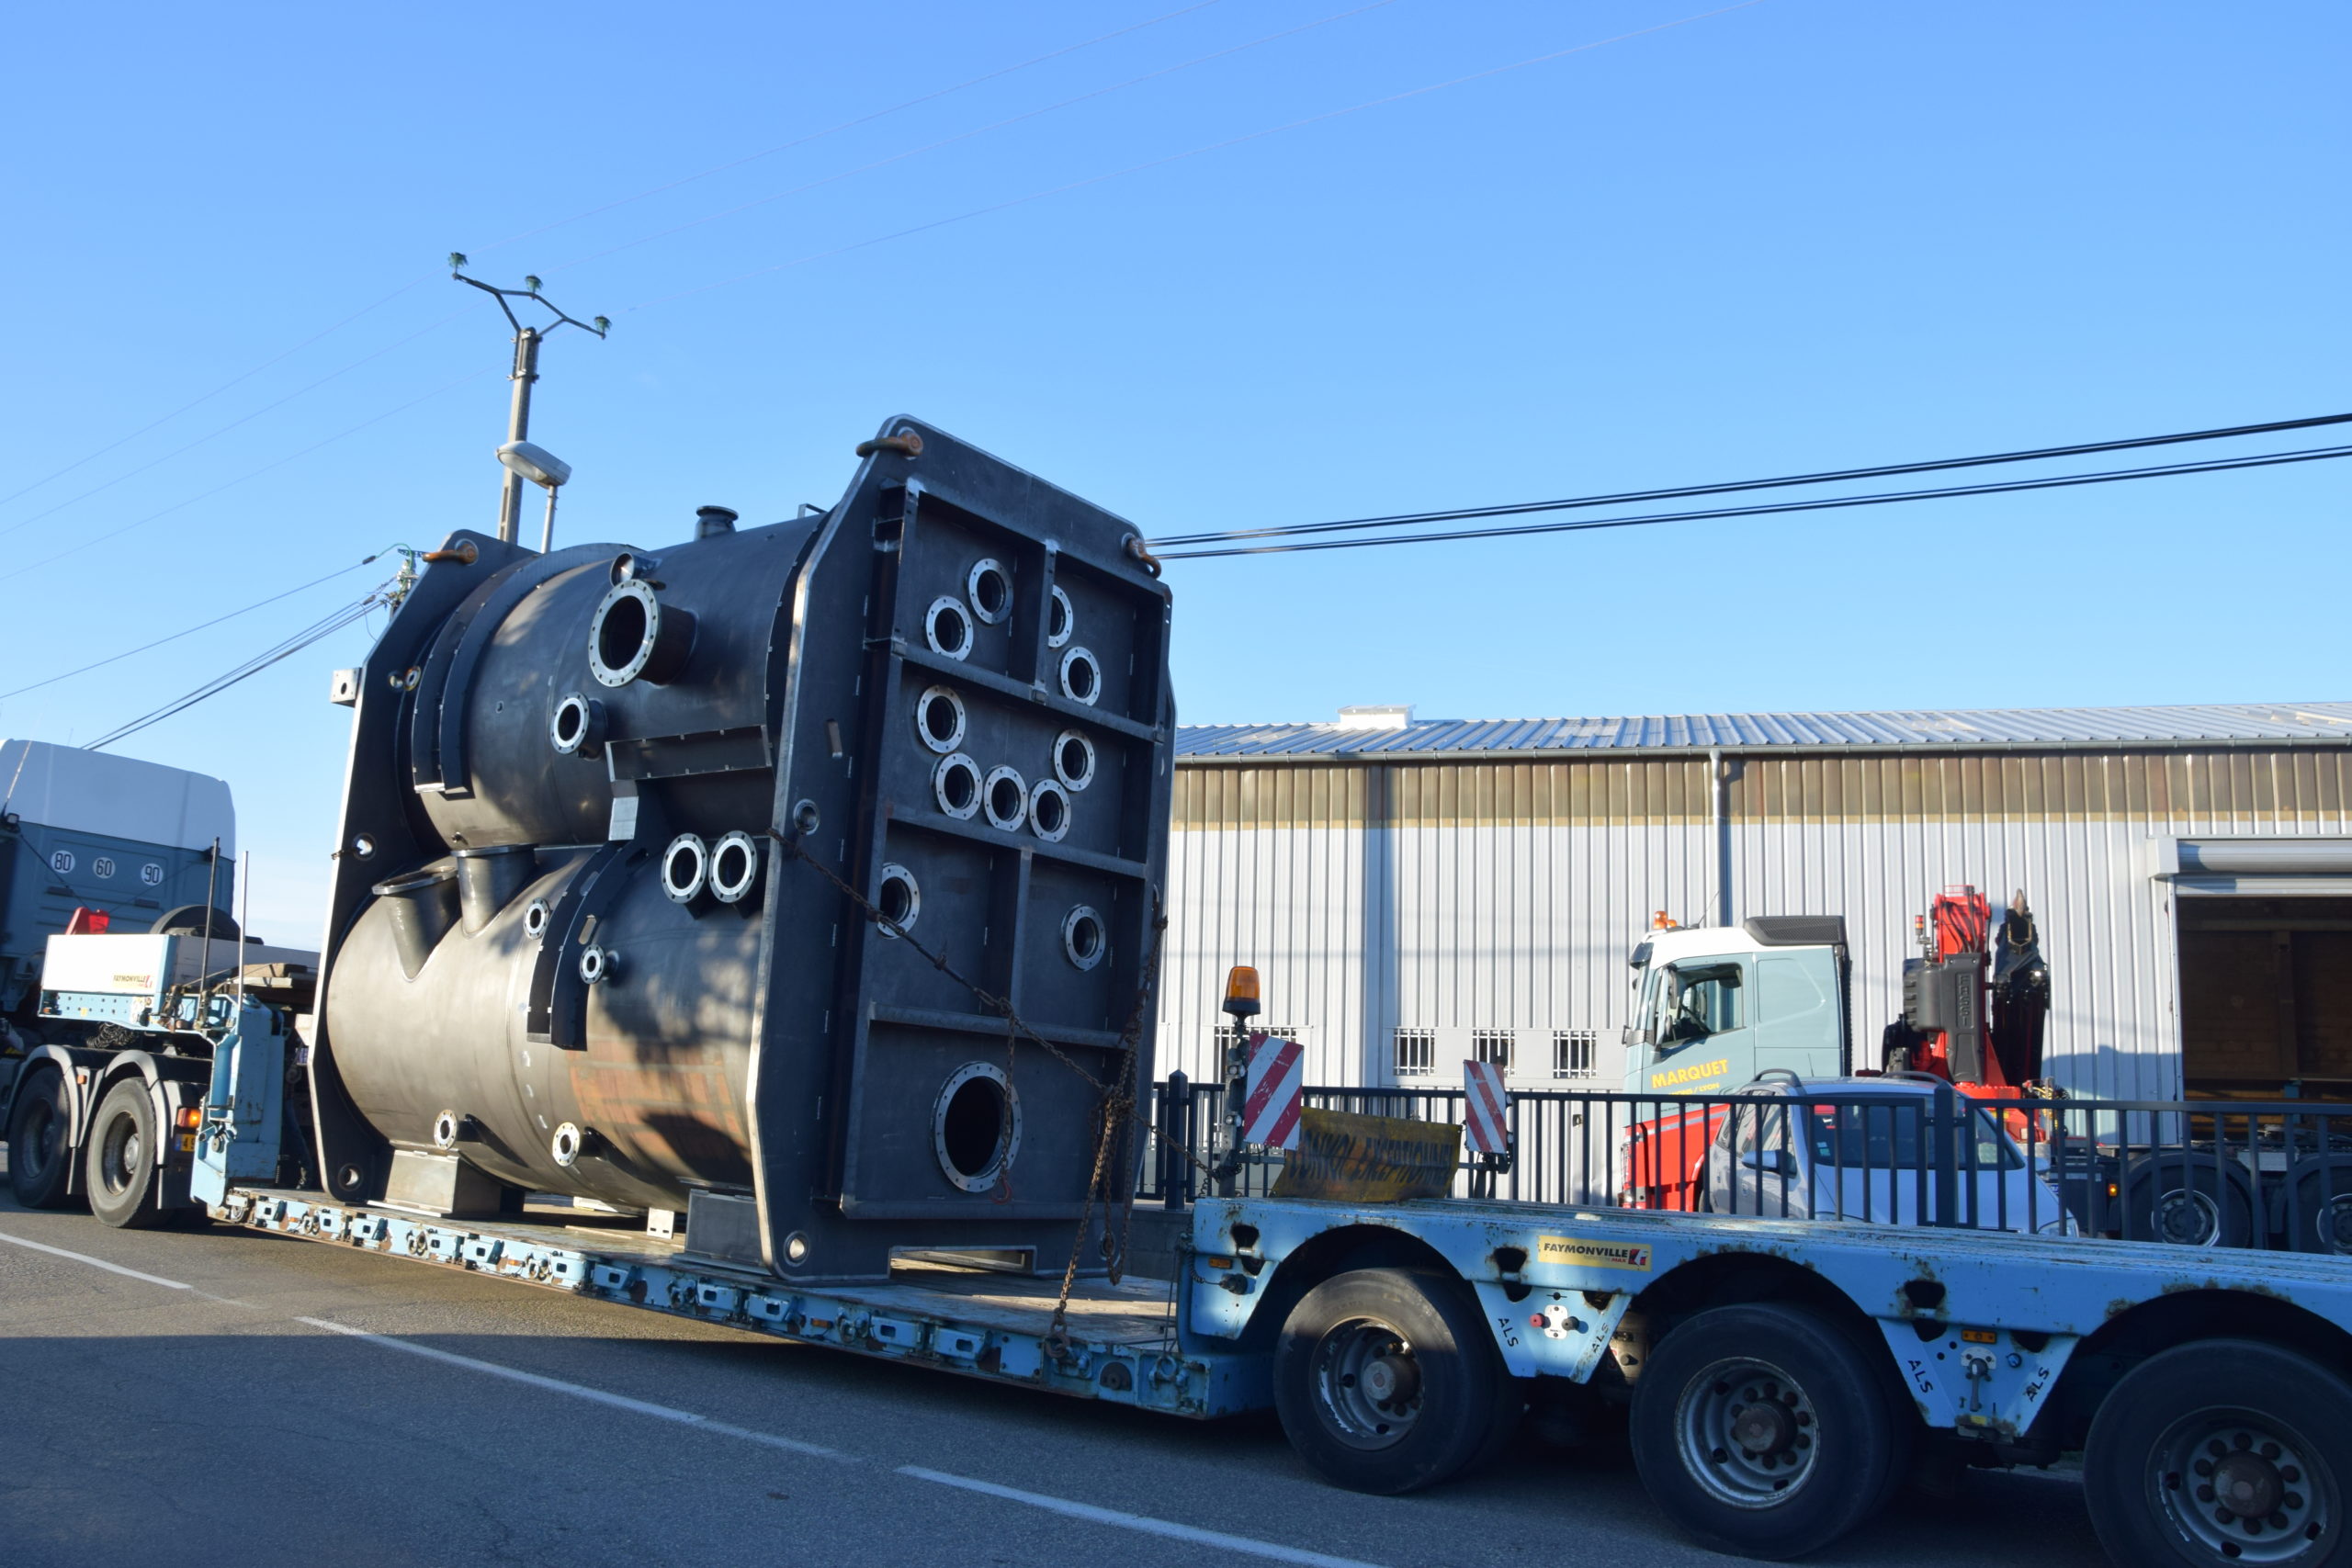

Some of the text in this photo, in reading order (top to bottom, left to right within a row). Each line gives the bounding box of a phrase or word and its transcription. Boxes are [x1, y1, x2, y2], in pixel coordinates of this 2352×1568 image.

[54, 852, 72, 872] 80
[96, 859, 112, 876] 60
[144, 865, 160, 884] 90
[1959, 974, 1970, 1027] FASSI
[1651, 1058, 1728, 1089] MARQUET
[1699, 1082, 1720, 1092] LYON
[1288, 1128, 1357, 1183] CONVOI
[1544, 1243, 1628, 1258] FAYMONVILLE
[1498, 1317, 1519, 1348] ALS
[1591, 1322, 1609, 1353] ALS
[1907, 1359, 1934, 1394] ALS
[2025, 1366, 2050, 1403] ALS
